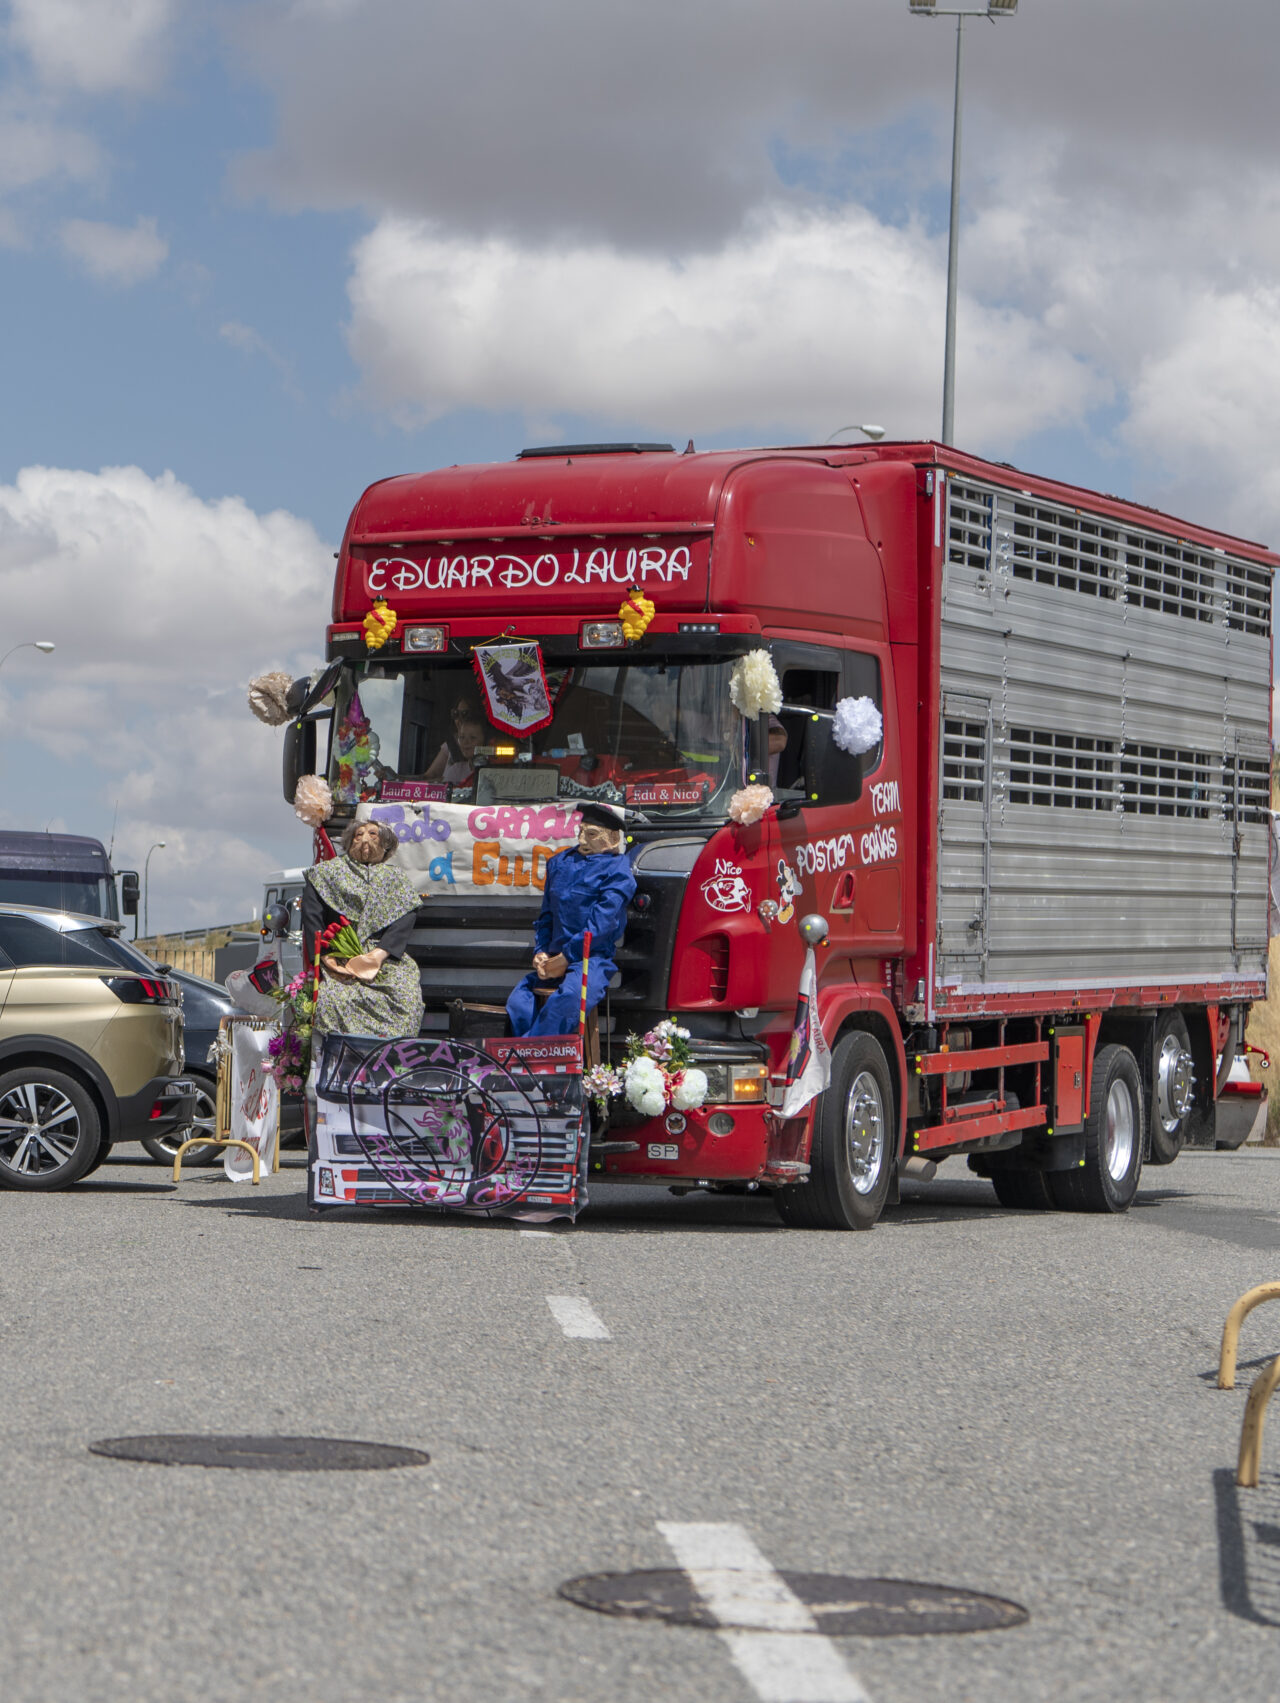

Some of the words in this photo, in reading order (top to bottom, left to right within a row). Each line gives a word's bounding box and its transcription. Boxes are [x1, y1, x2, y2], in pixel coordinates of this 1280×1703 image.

[369, 553, 559, 591] EDUARDO
[564, 546, 692, 584] LAURA
[382, 784, 411, 798] Laura
[413, 786, 422, 798] &
[633, 789, 656, 801] Edu
[660, 788, 669, 800] &
[672, 788, 700, 800] Nico
[869, 781, 901, 817] TEAM
[468, 803, 586, 842] GRACIA
[860, 823, 898, 865] CAÑAS
[472, 841, 572, 892] ELLO
[714, 858, 742, 875] Nico
[372, 1040, 496, 1083] TEAM
[549, 1046, 578, 1057] LAURA
[650, 1145, 675, 1157] SP
